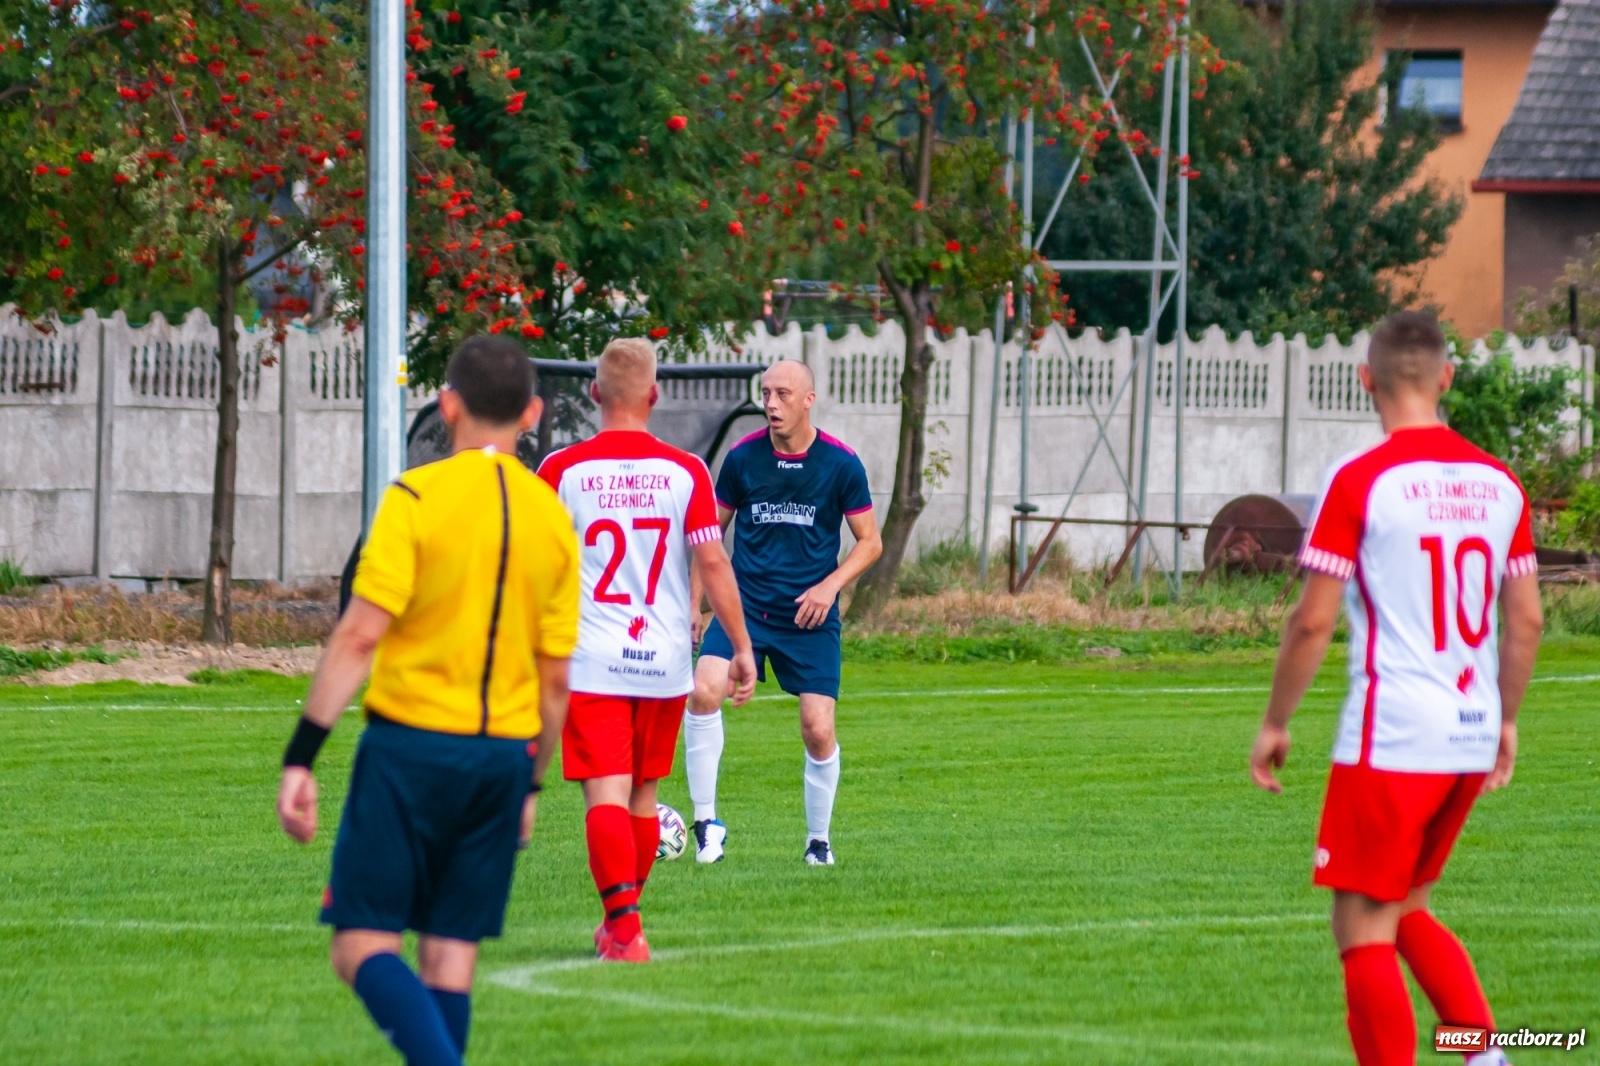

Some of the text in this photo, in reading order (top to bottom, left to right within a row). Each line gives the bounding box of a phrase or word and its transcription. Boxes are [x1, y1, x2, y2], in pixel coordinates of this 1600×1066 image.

[581, 474, 671, 491] LKS ZAMECZEK
[1403, 481, 1431, 499] LKS
[598, 493, 655, 508] CZERNICA
[585, 517, 671, 605] 27
[1420, 536, 1493, 651] 10
[622, 646, 657, 661] Husar
